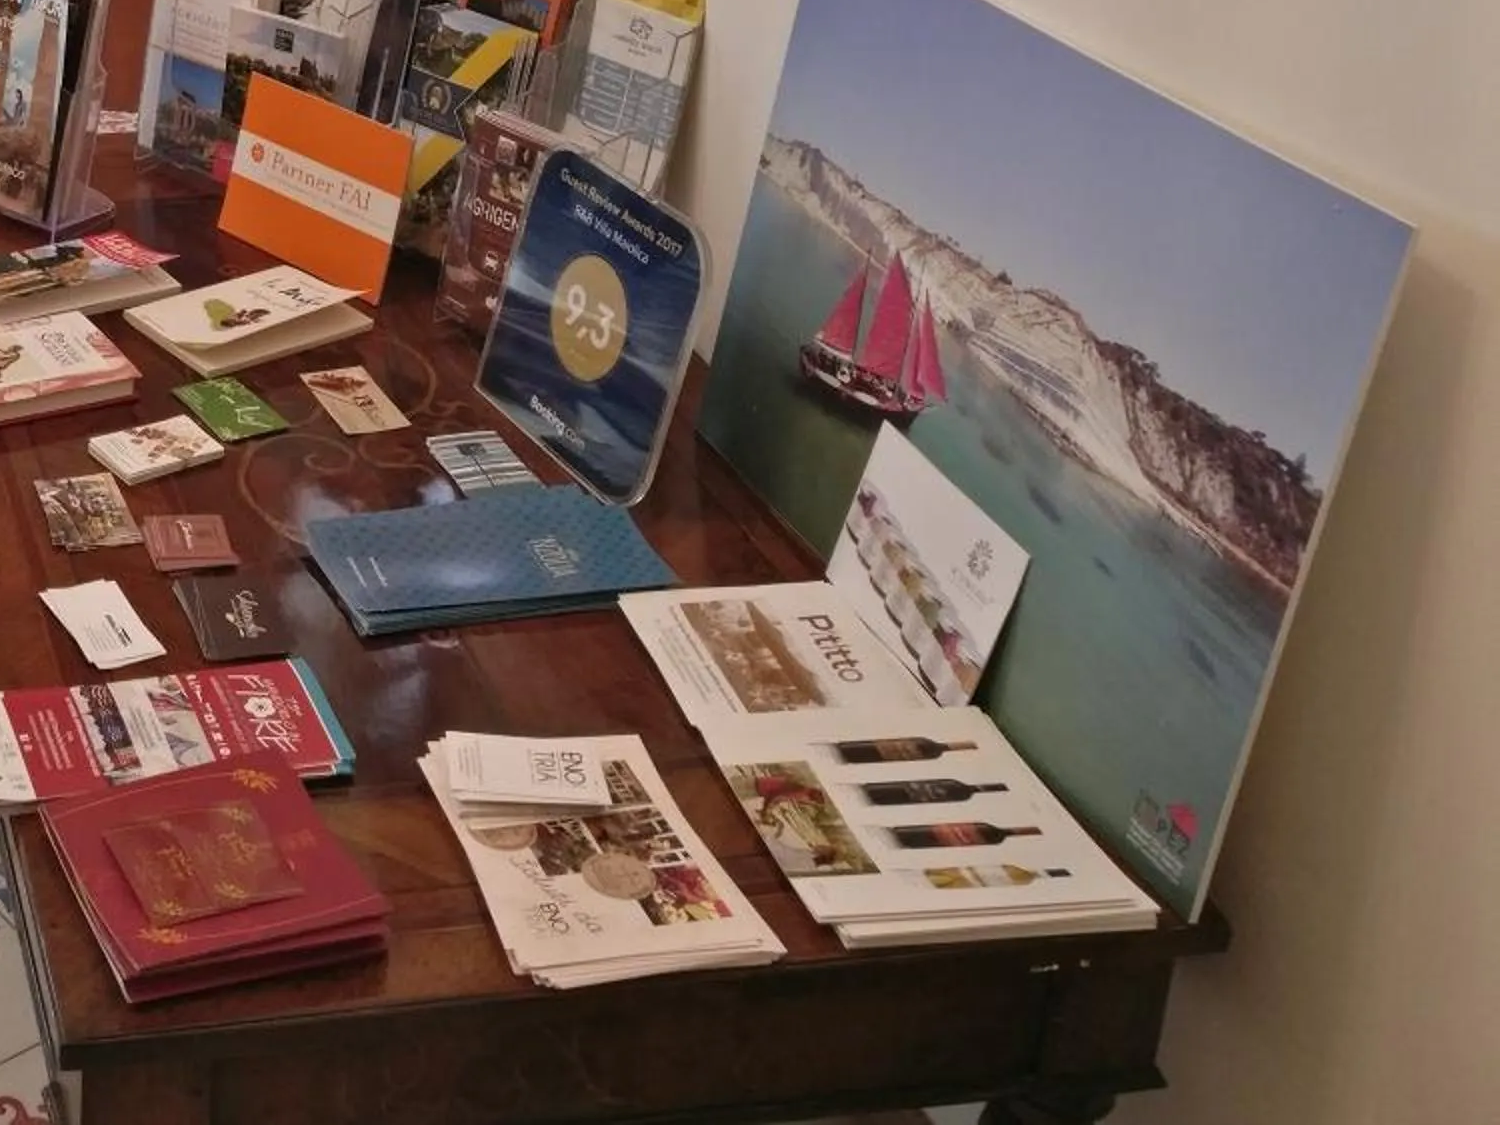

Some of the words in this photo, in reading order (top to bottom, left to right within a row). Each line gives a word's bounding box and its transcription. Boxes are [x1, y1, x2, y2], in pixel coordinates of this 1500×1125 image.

[272, 150, 336, 195] Partner
[561, 167, 589, 196] Guest
[588, 186, 621, 216] Review
[621, 209, 656, 242] Awards
[655, 231, 683, 257] 2017
[227, 674, 299, 753] FIORE
[532, 751, 558, 782] TRIA
[561, 751, 587, 787] ENO
[539, 902, 570, 934] ENO
